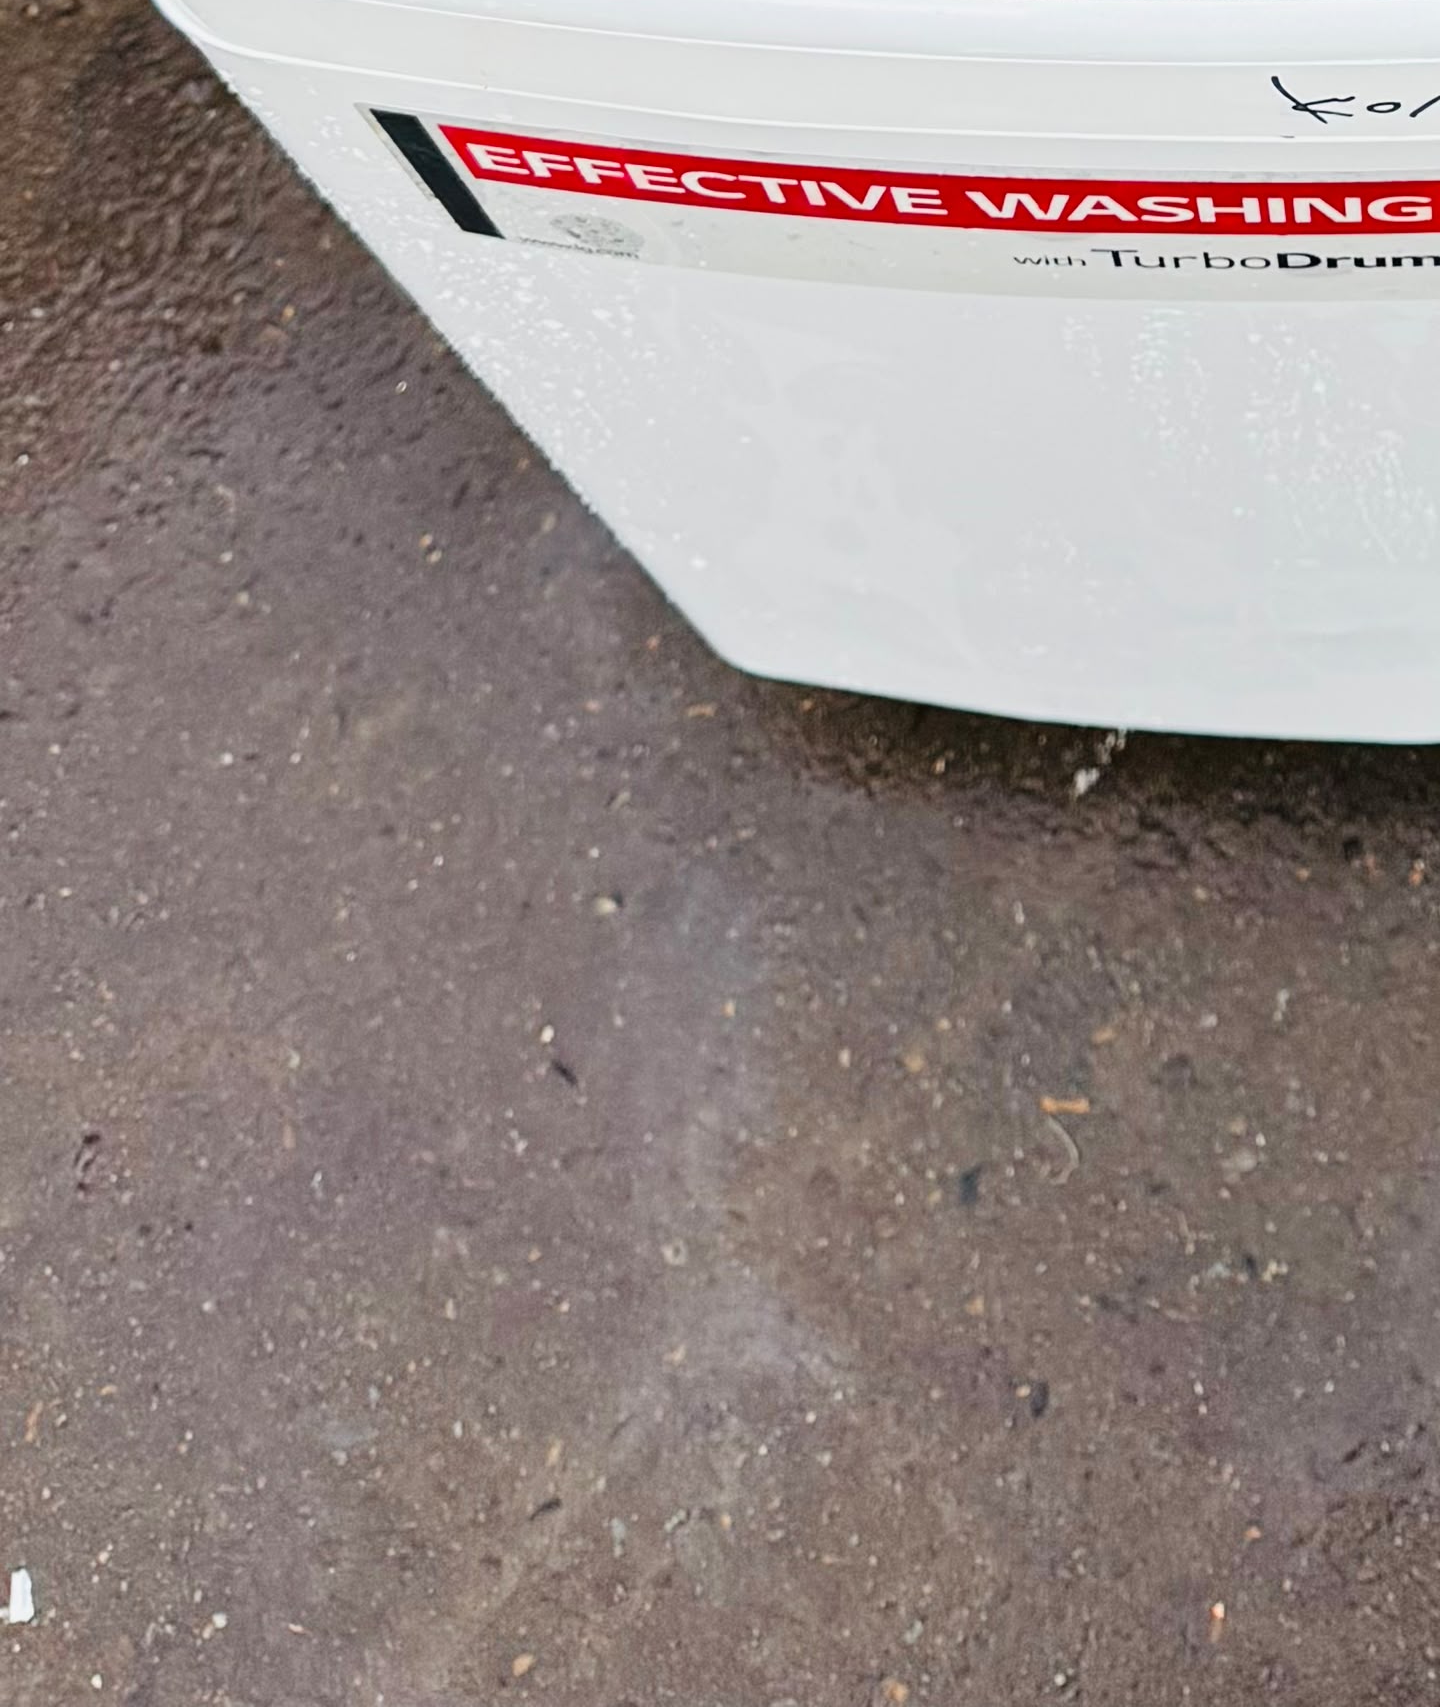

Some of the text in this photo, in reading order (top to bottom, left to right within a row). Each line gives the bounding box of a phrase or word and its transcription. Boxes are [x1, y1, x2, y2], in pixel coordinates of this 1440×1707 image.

[464, 141, 1434, 224] EFFECTIVE WASHING
[1012, 254, 1087, 268] with
